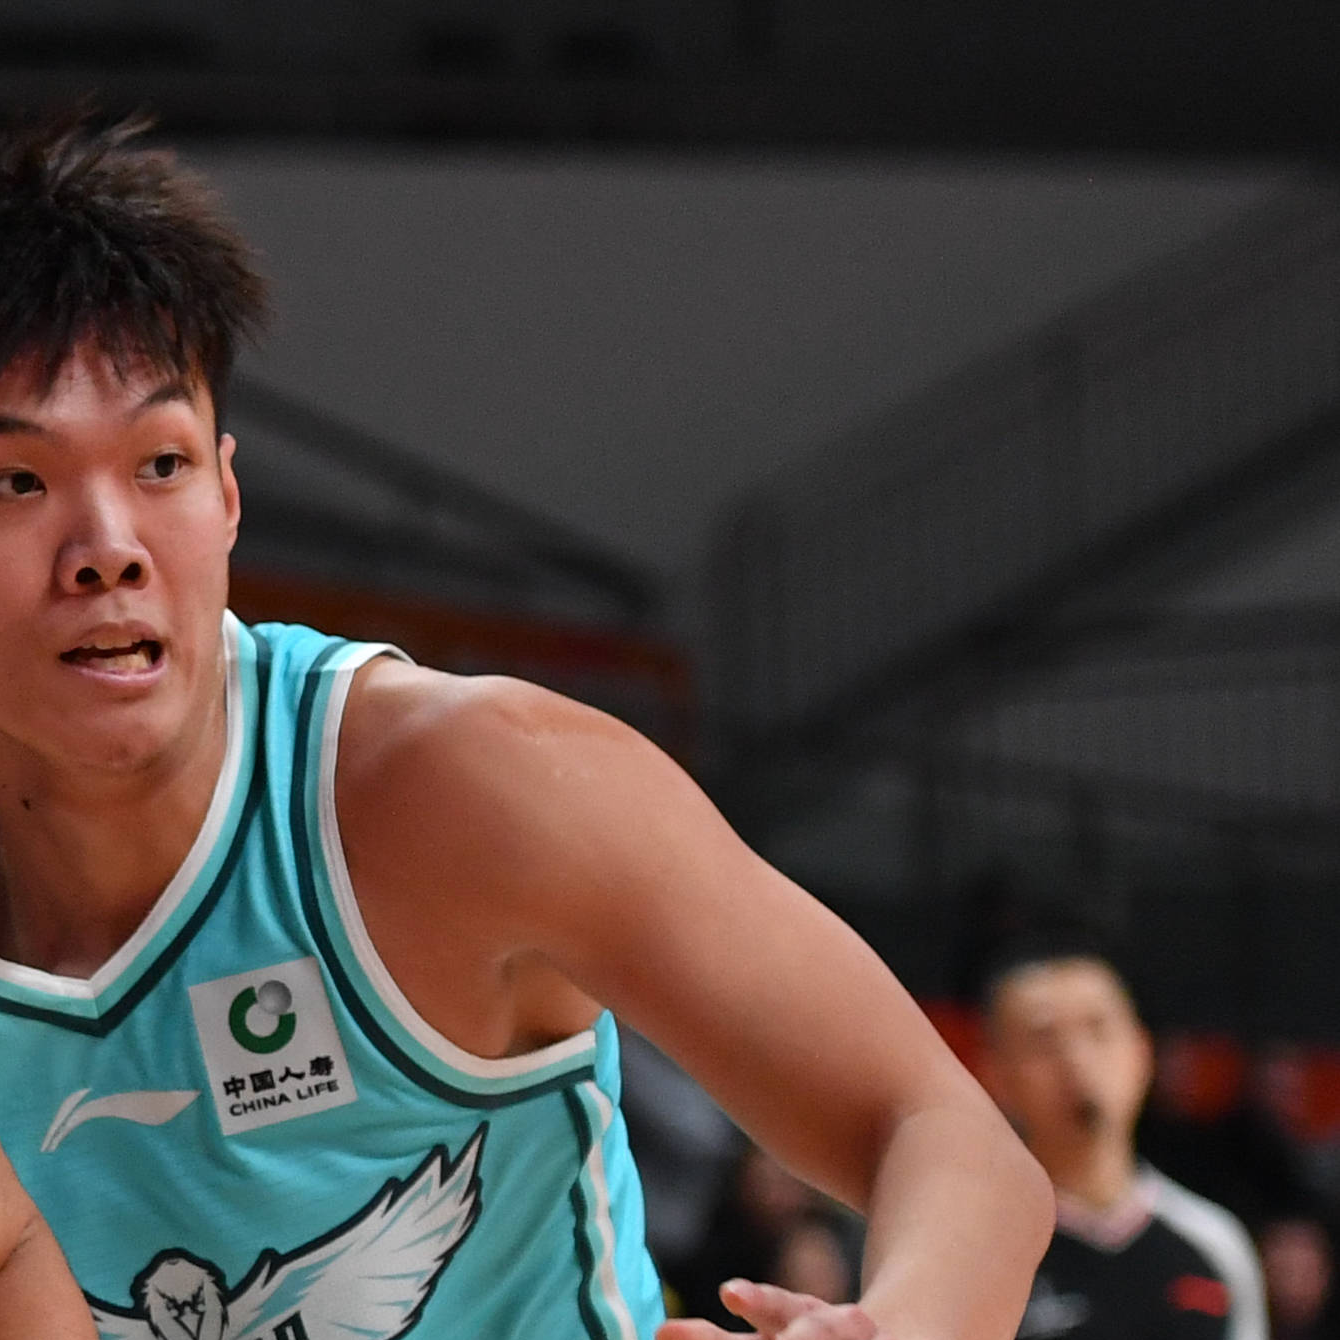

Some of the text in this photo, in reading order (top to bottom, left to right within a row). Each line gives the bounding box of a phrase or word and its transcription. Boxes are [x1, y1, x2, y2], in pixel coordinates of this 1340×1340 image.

[222, 1055, 335, 1099] 中国人寿
[229, 1079, 339, 1117] CHINA LIFE
